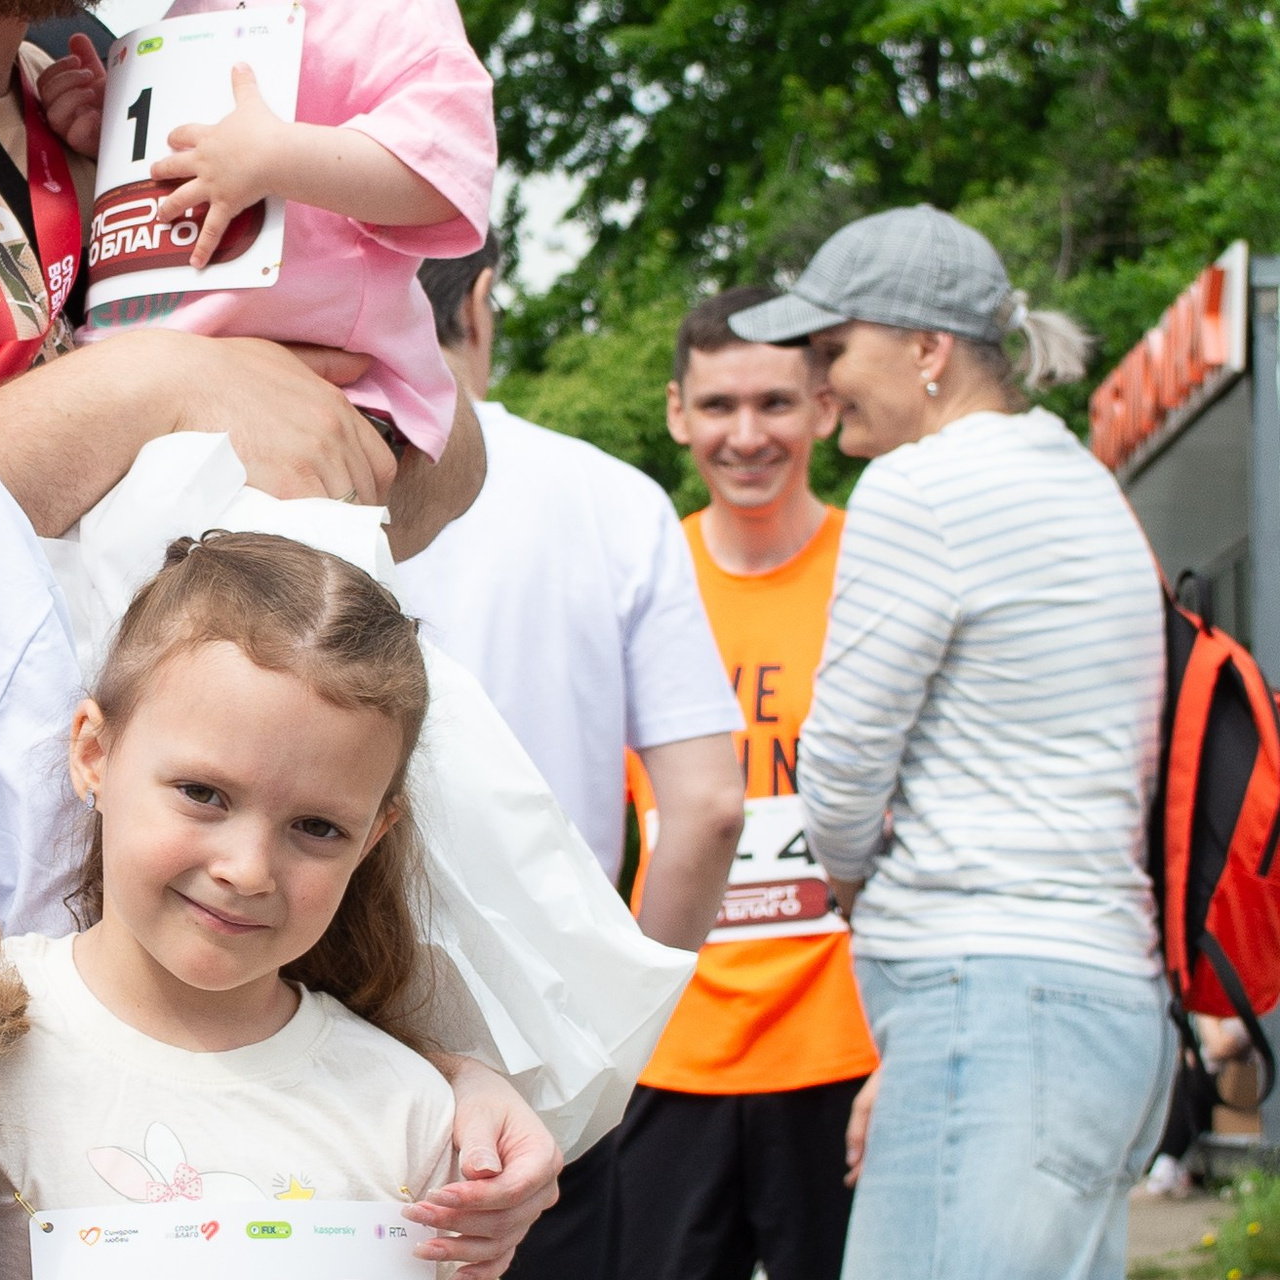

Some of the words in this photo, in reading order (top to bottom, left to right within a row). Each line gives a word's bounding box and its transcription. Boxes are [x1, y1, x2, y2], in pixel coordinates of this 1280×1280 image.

[100, 221, 199, 261] БЛАГО
[175, 1224, 199, 1232] СПОРТ
[314, 1225, 357, 1237] kaspersky
[389, 1226, 408, 1238] RTA
